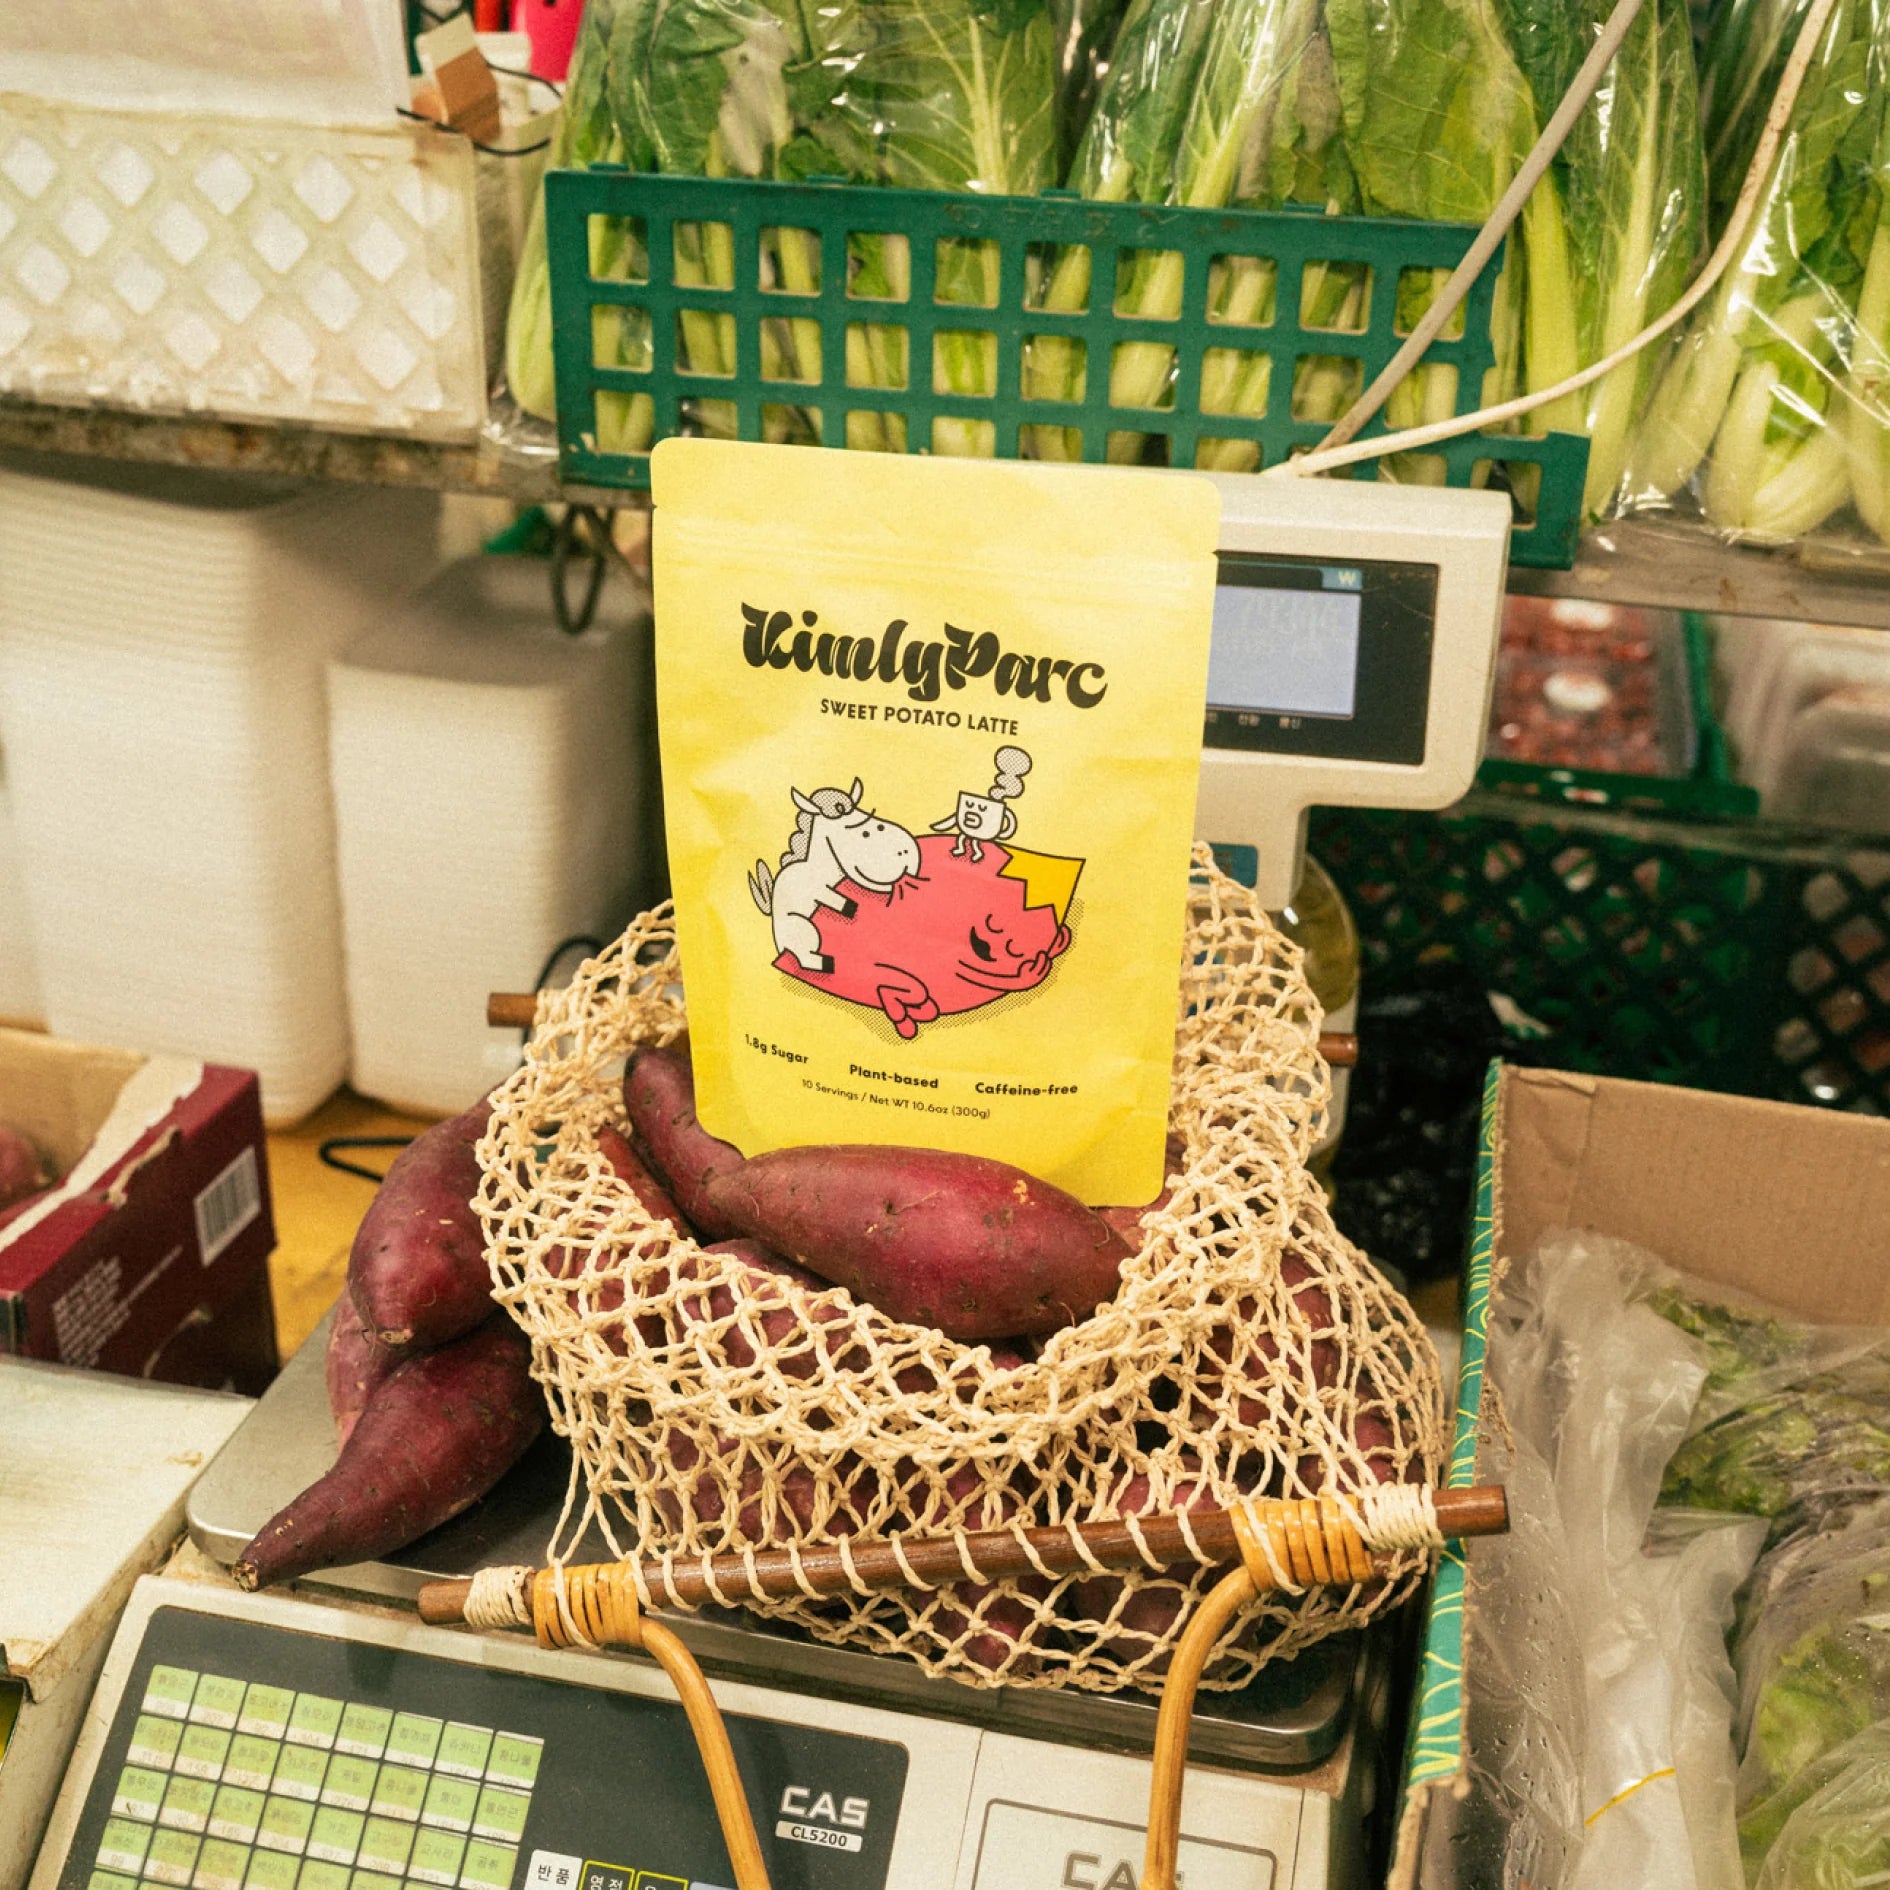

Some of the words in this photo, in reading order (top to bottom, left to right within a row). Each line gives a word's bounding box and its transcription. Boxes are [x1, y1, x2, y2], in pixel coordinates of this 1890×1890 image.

[741, 602, 1108, 709] KimlyParc
[820, 698, 878, 721] SWEET
[884, 706, 961, 728] POTATO
[968, 714, 1019, 736] LATTE
[745, 1033, 767, 1054] 1.8g
[771, 1043, 809, 1065] Sugar
[849, 1064, 939, 1089] Plant-based
[975, 1081, 1079, 1097] Caffeine-free
[802, 1079, 813, 1089] 10
[815, 1081, 859, 1101] Servings
[869, 1094, 890, 1107] Net
[892, 1098, 910, 1110] WT
[912, 1100, 949, 1114] 10.6oz
[951, 1105, 991, 1120] (300g)
[780, 1785, 870, 1829] CAS
[791, 1826, 848, 1847] CL5200
[1061, 1850, 1184, 1890] CA
